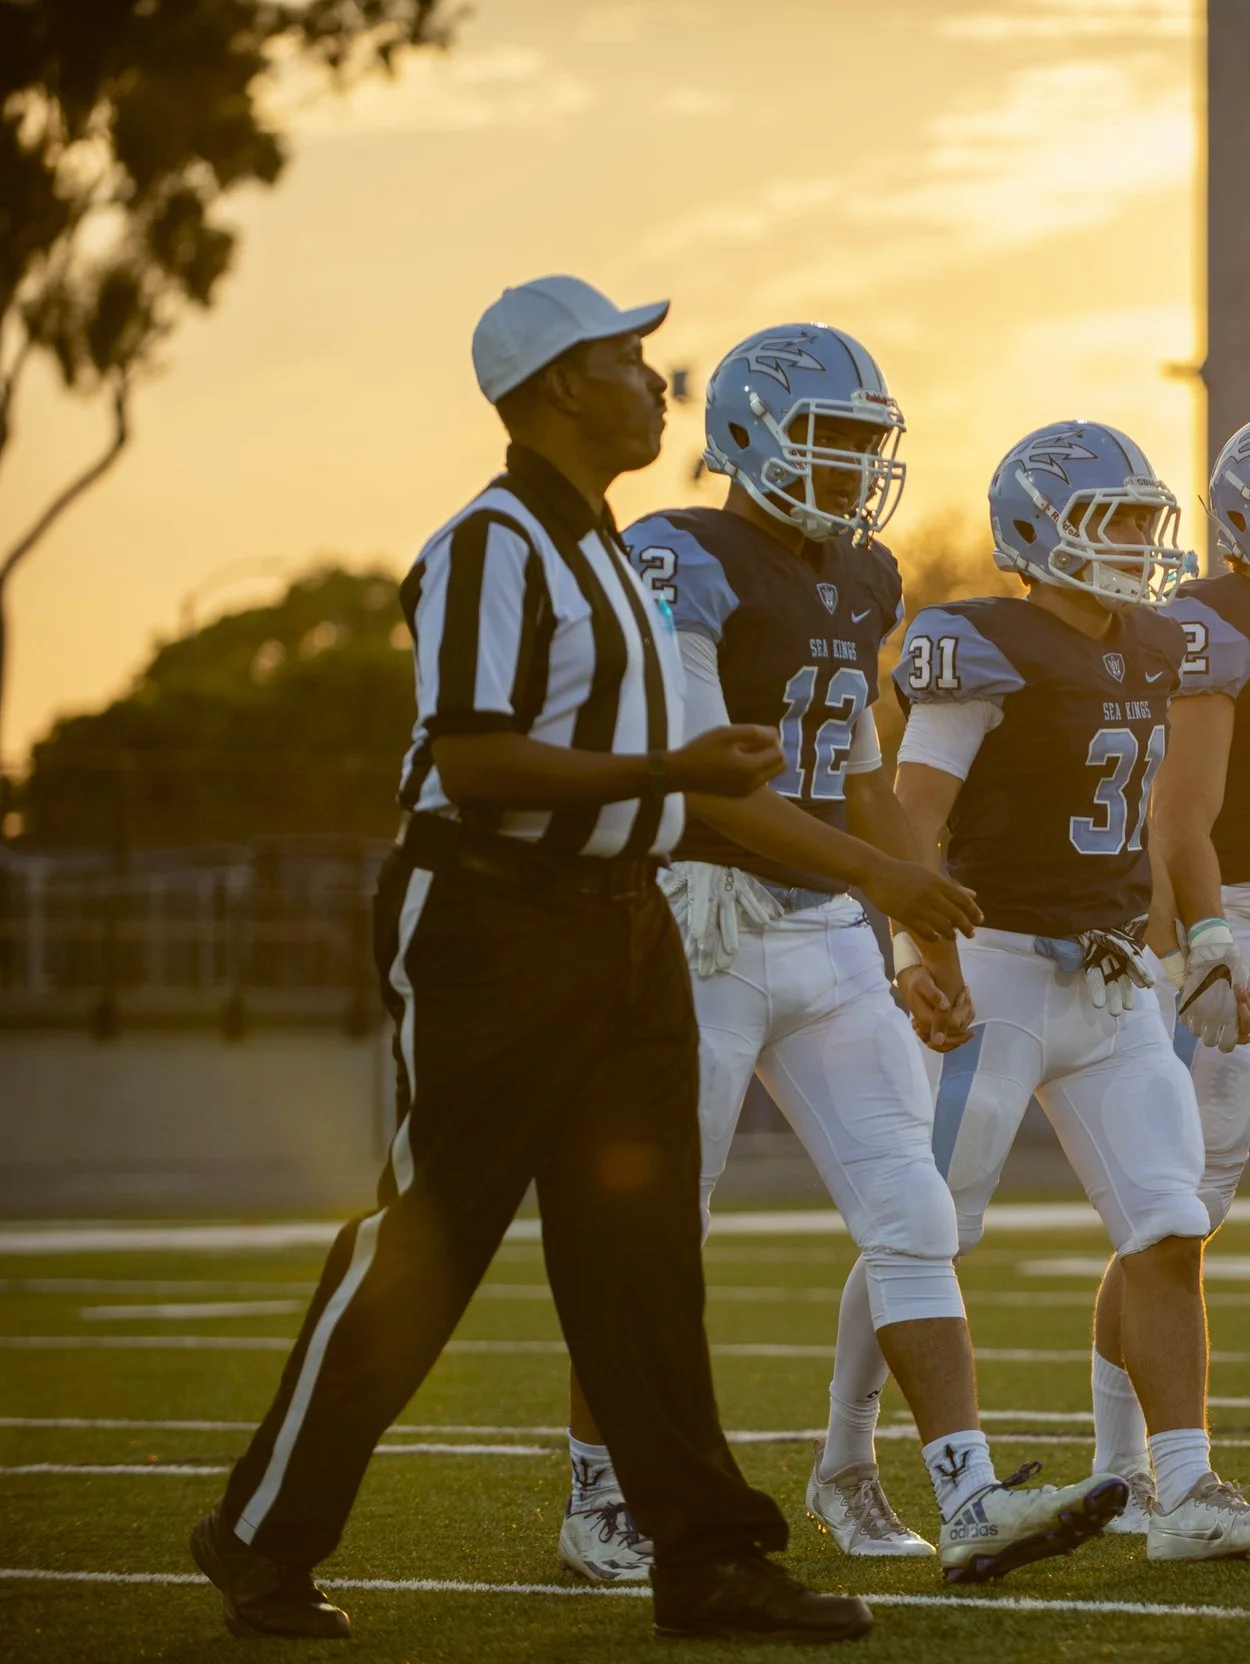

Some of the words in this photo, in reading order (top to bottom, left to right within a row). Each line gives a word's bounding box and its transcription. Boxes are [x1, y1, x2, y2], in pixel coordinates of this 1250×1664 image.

[625, 545, 678, 604] 2
[809, 638, 829, 658] SEA
[832, 639, 857, 661] KINGS
[908, 634, 961, 690] 31
[1180, 621, 1209, 675] 2
[767, 665, 868, 800] 12
[1102, 702, 1122, 721] SEA
[1124, 700, 1152, 720] KINGS
[1069, 724, 1165, 855] 31
[949, 1522, 999, 1541] adidas
